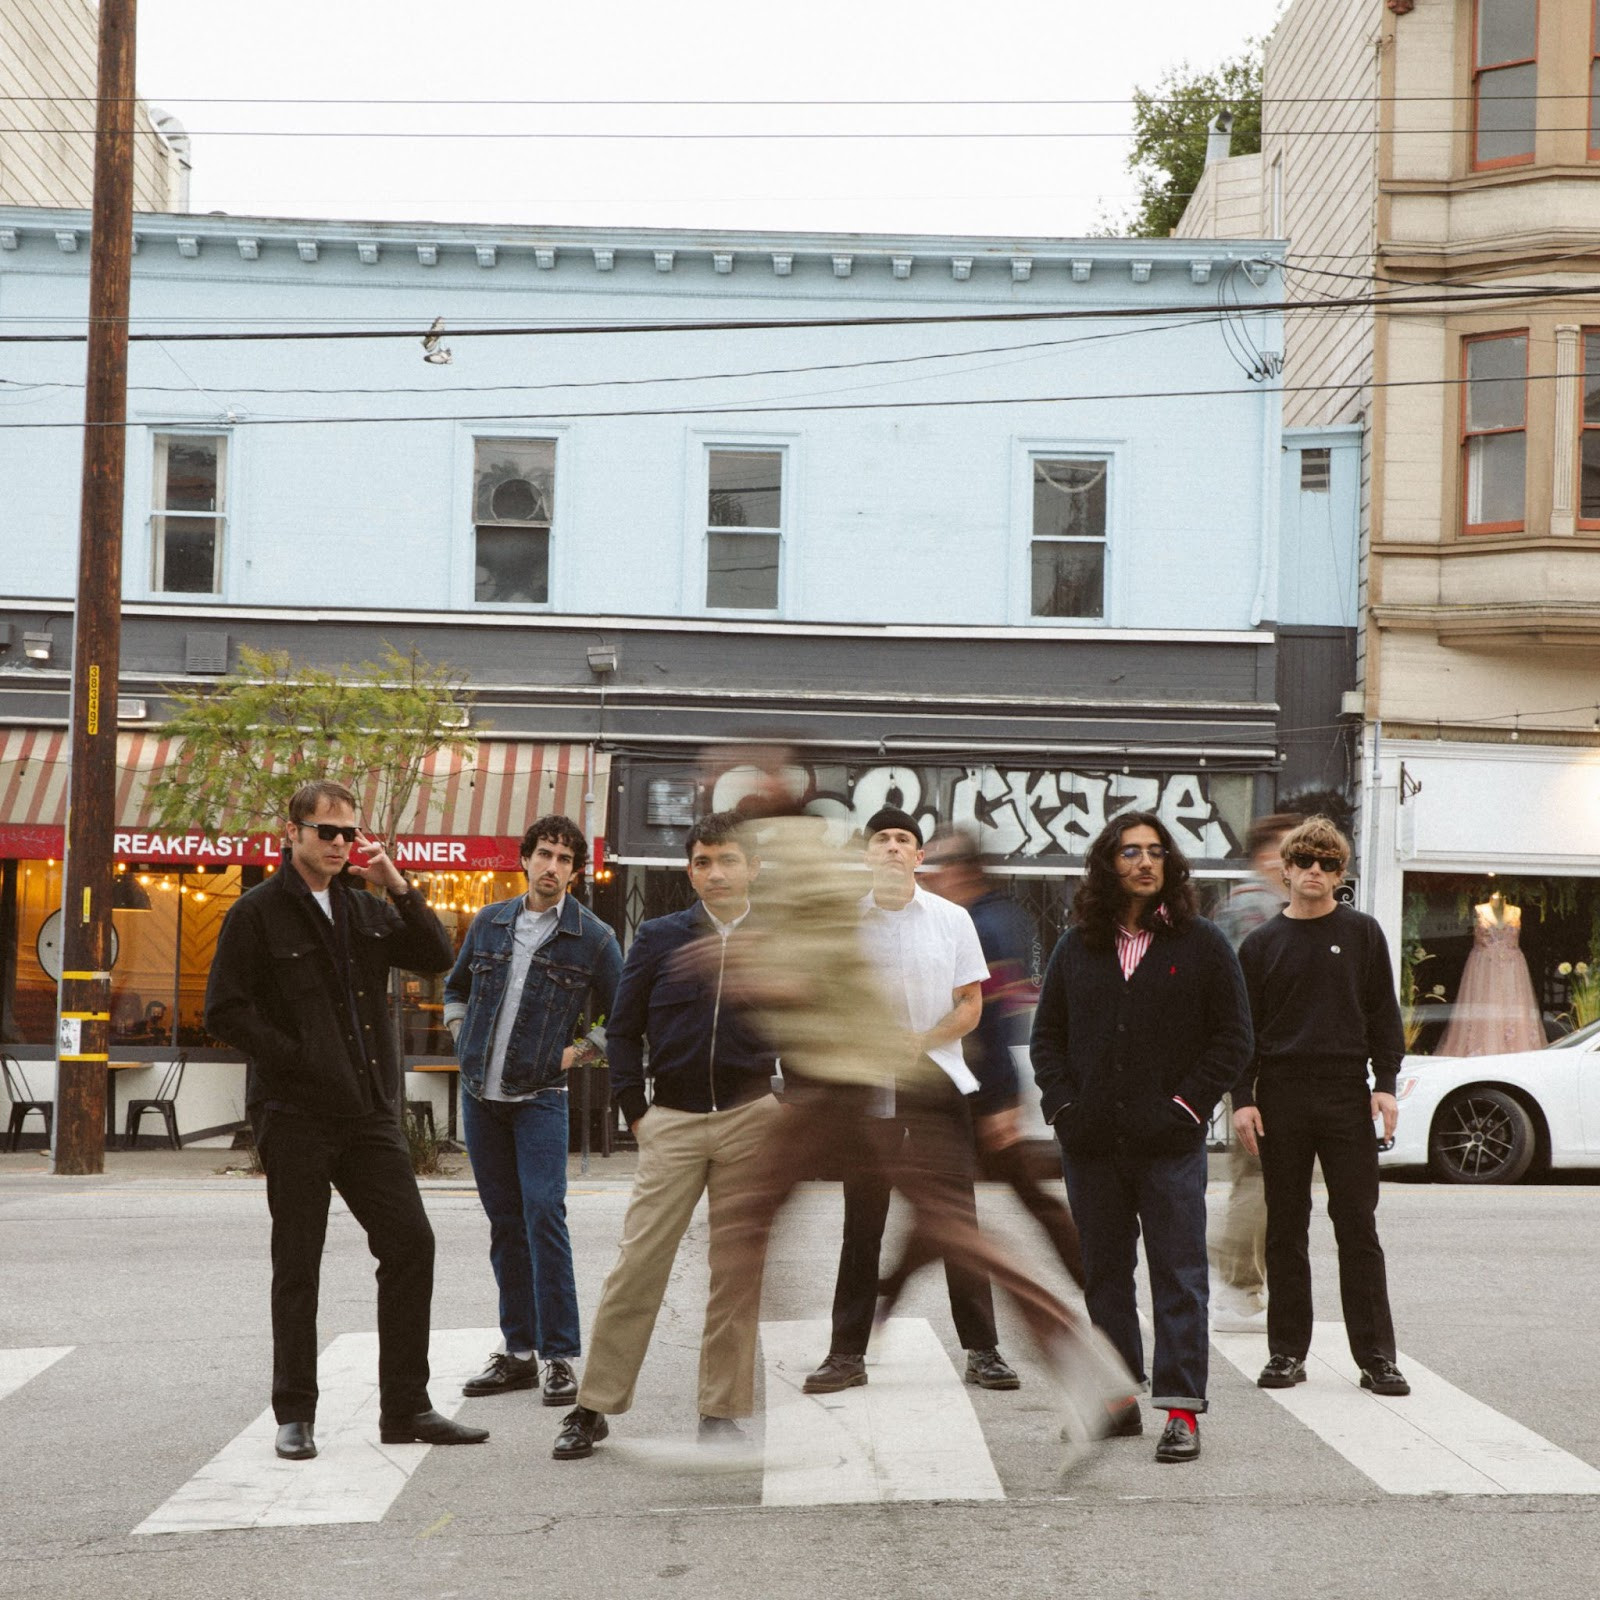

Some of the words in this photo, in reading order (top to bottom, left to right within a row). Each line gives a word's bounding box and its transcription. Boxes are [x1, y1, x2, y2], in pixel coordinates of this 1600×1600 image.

[89, 666, 98, 733] 383497
[113, 833, 248, 857] REAKFAST
[376, 841, 467, 862] NNER
